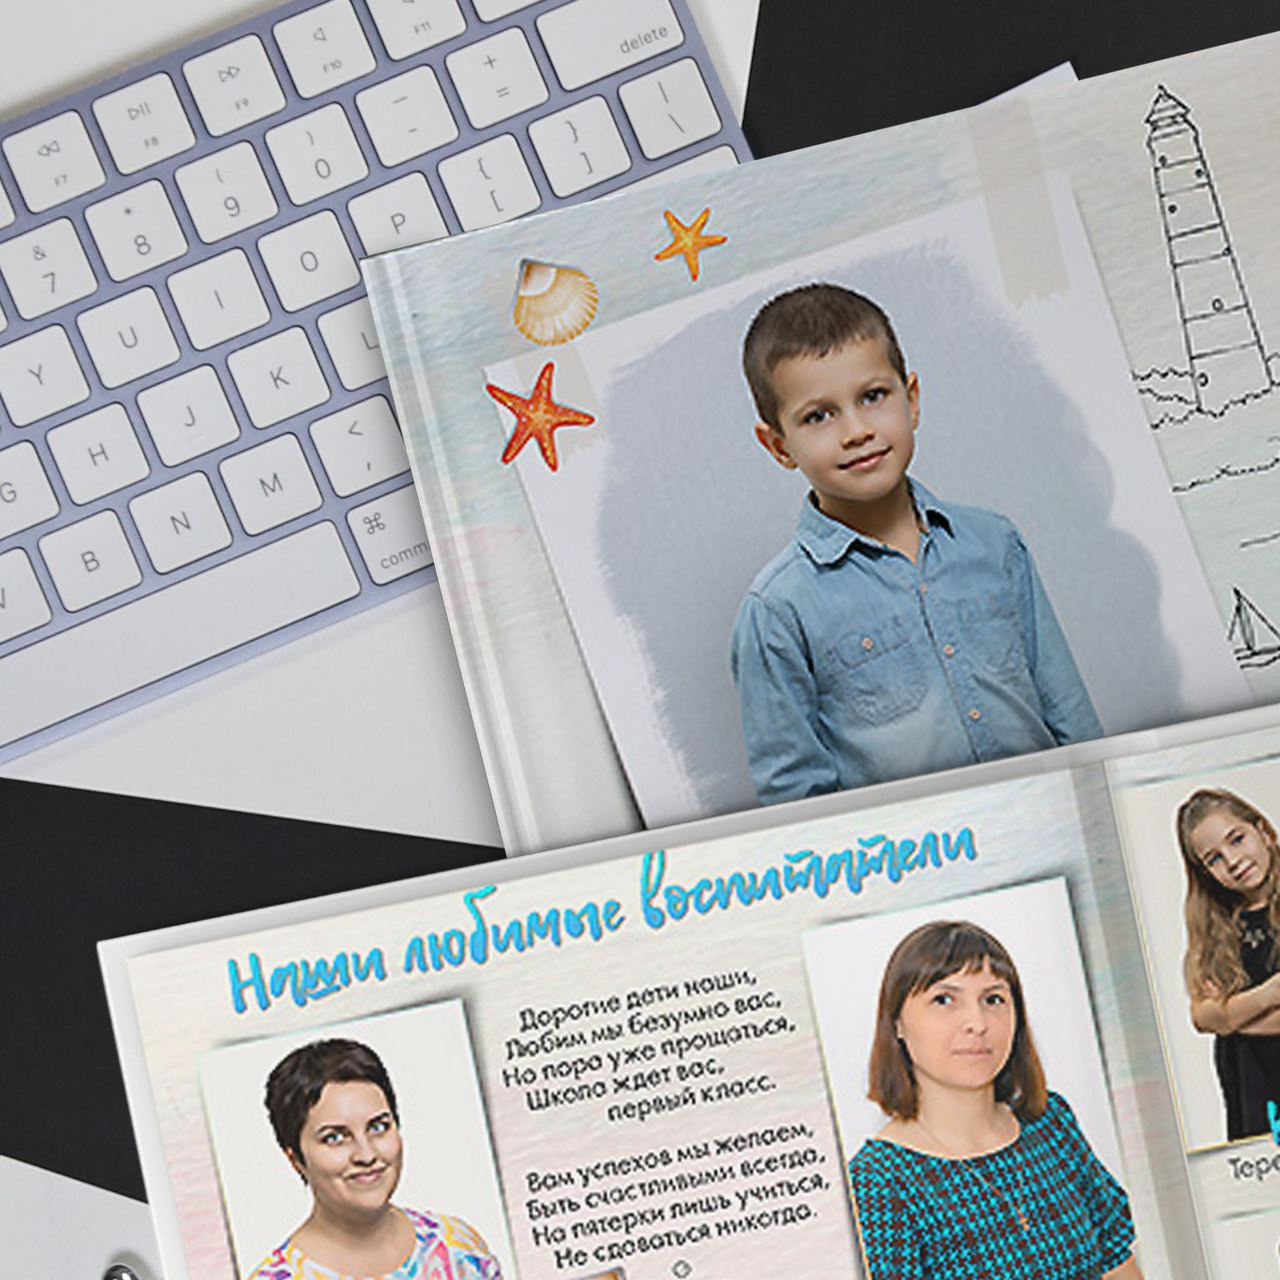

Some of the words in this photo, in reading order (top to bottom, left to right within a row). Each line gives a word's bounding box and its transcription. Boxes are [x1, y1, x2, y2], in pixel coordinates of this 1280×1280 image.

[619, 25, 669, 54] delete
[484, 55, 497, 69] +
[224, 197, 240, 217] 9
[390, 213, 406, 235] P
[33, 246, 47, 261] &
[134, 235, 151, 255] 8
[42, 272, 56, 293] 7
[118, 326, 138, 348] U
[361, 332, 379, 350] L
[28, 365, 44, 385] Y
[269, 366, 290, 389] K
[184, 406, 197, 428] J
[87, 443, 110, 467] H
[0, 482, 17, 503] G
[259, 472, 284, 497] M
[169, 510, 192, 535] N
[81, 550, 101, 572] B
[381, 542, 430, 569] comm
[227, 948, 386, 1014] Наши
[403, 885, 625, 974] любимые
[640, 827, 978, 930] воспитатели
[519, 995, 621, 1033] Дорогие
[627, 984, 679, 1010] дети
[684, 971, 757, 996] наши,
[505, 1029, 587, 1061] Любим
[591, 1023, 623, 1044] мы
[628, 1001, 730, 1036] безумно
[734, 991, 781, 1014] вас,
[541, 1054, 603, 1080] пора
[607, 1044, 656, 1073] уже
[660, 1016, 796, 1059] прощаться,
[525, 1081, 607, 1112] Школа
[612, 1065, 672, 1094] ждет
[676, 1058, 725, 1081] вас,
[607, 1086, 697, 1123] первый
[700, 1075, 777, 1103] класс.
[526, 1171, 575, 1193] Вам
[576, 1149, 673, 1188] успехов
[677, 1142, 710, 1163] мы
[713, 1123, 814, 1155] желаем,
[525, 1197, 581, 1220] Быть
[585, 1165, 736, 1209] счастливыми
[740, 1147, 826, 1177] всегда,
[571, 1207, 665, 1239] пятерки
[669, 1195, 732, 1220] лишь
[735, 1173, 830, 1211] учиться,
[554, 1247, 588, 1269] Не
[592, 1223, 712, 1262] сдаваться
[715, 1204, 818, 1237] никогда.
